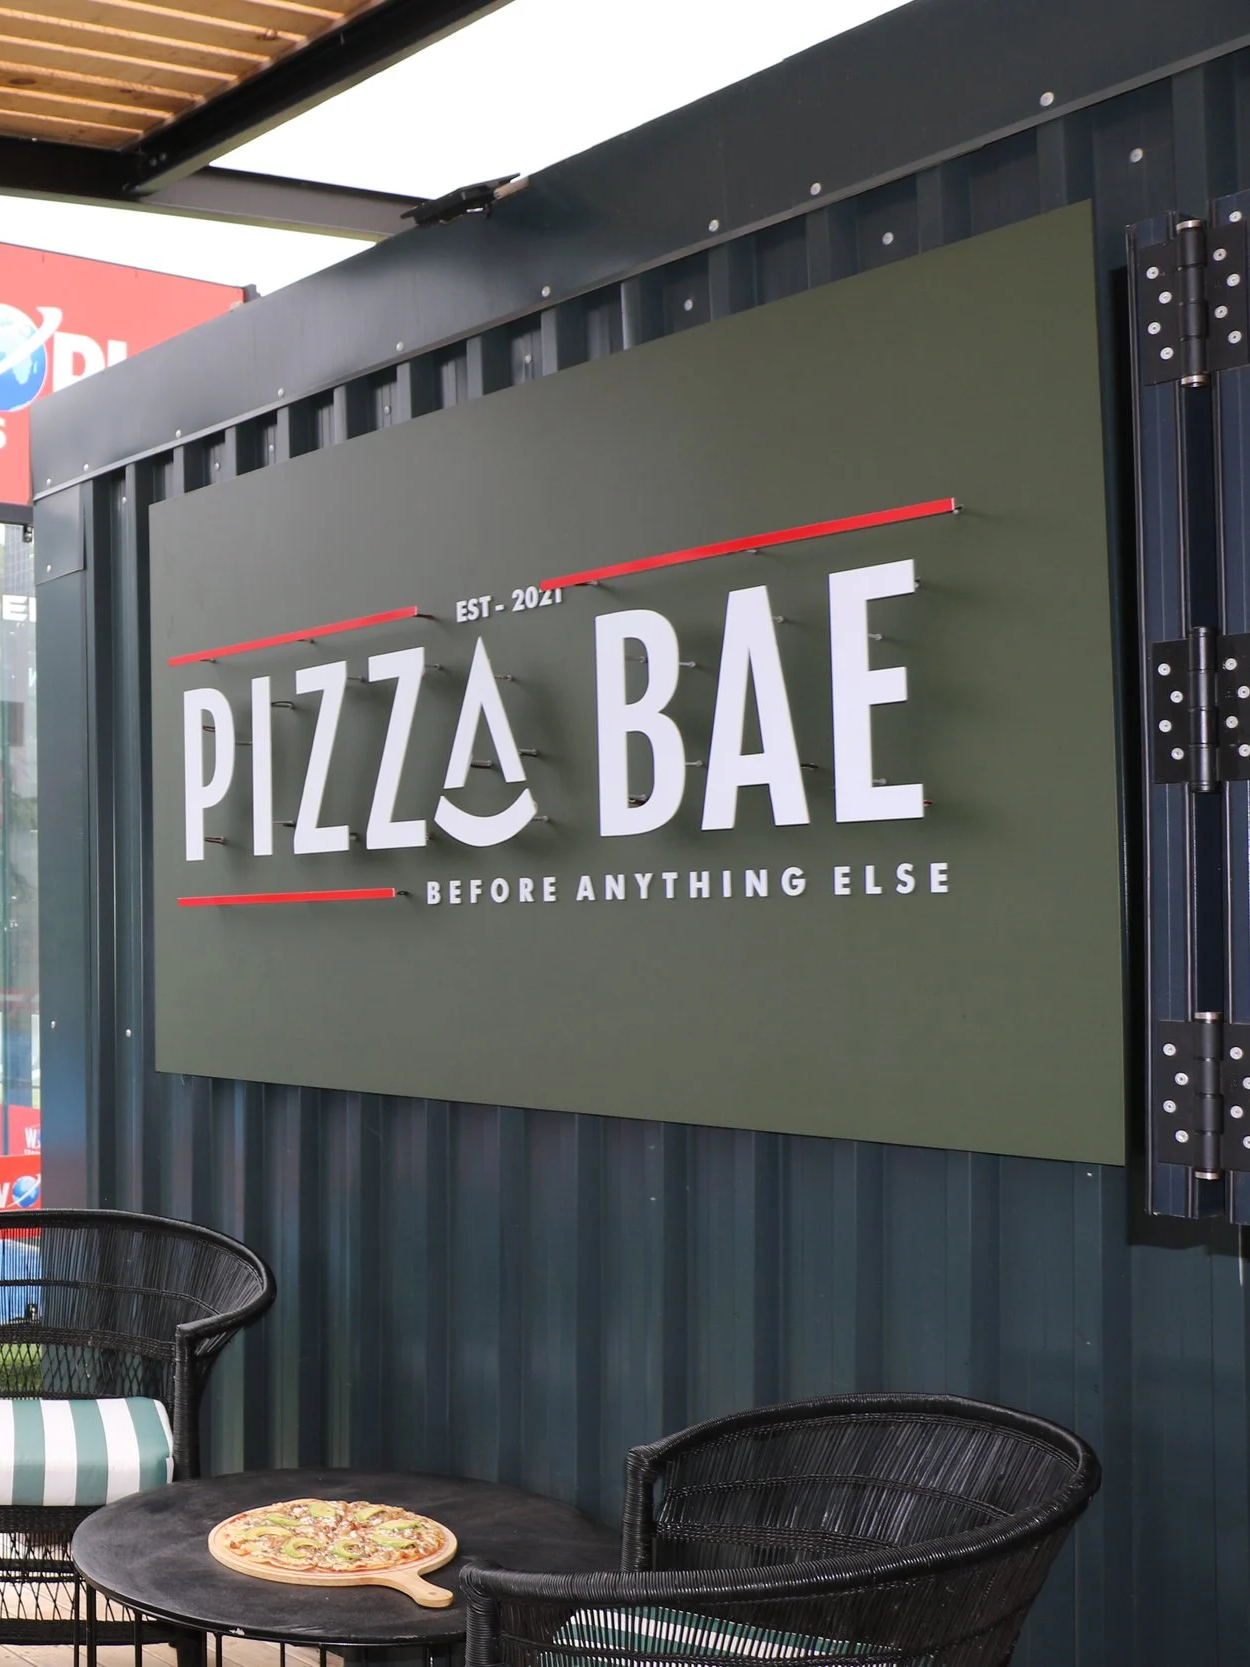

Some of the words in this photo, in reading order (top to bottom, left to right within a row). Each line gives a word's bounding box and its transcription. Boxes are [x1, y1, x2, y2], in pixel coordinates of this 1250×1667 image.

[456, 595, 492, 623] EST
[511, 586, 562, 612] 2021
[184, 636, 538, 861] PIZZA
[595, 559, 925, 837] BAE
[426, 876, 557, 905] BEFORE
[576, 866, 807, 901] ANYTHING
[833, 862, 949, 895] ELSE
